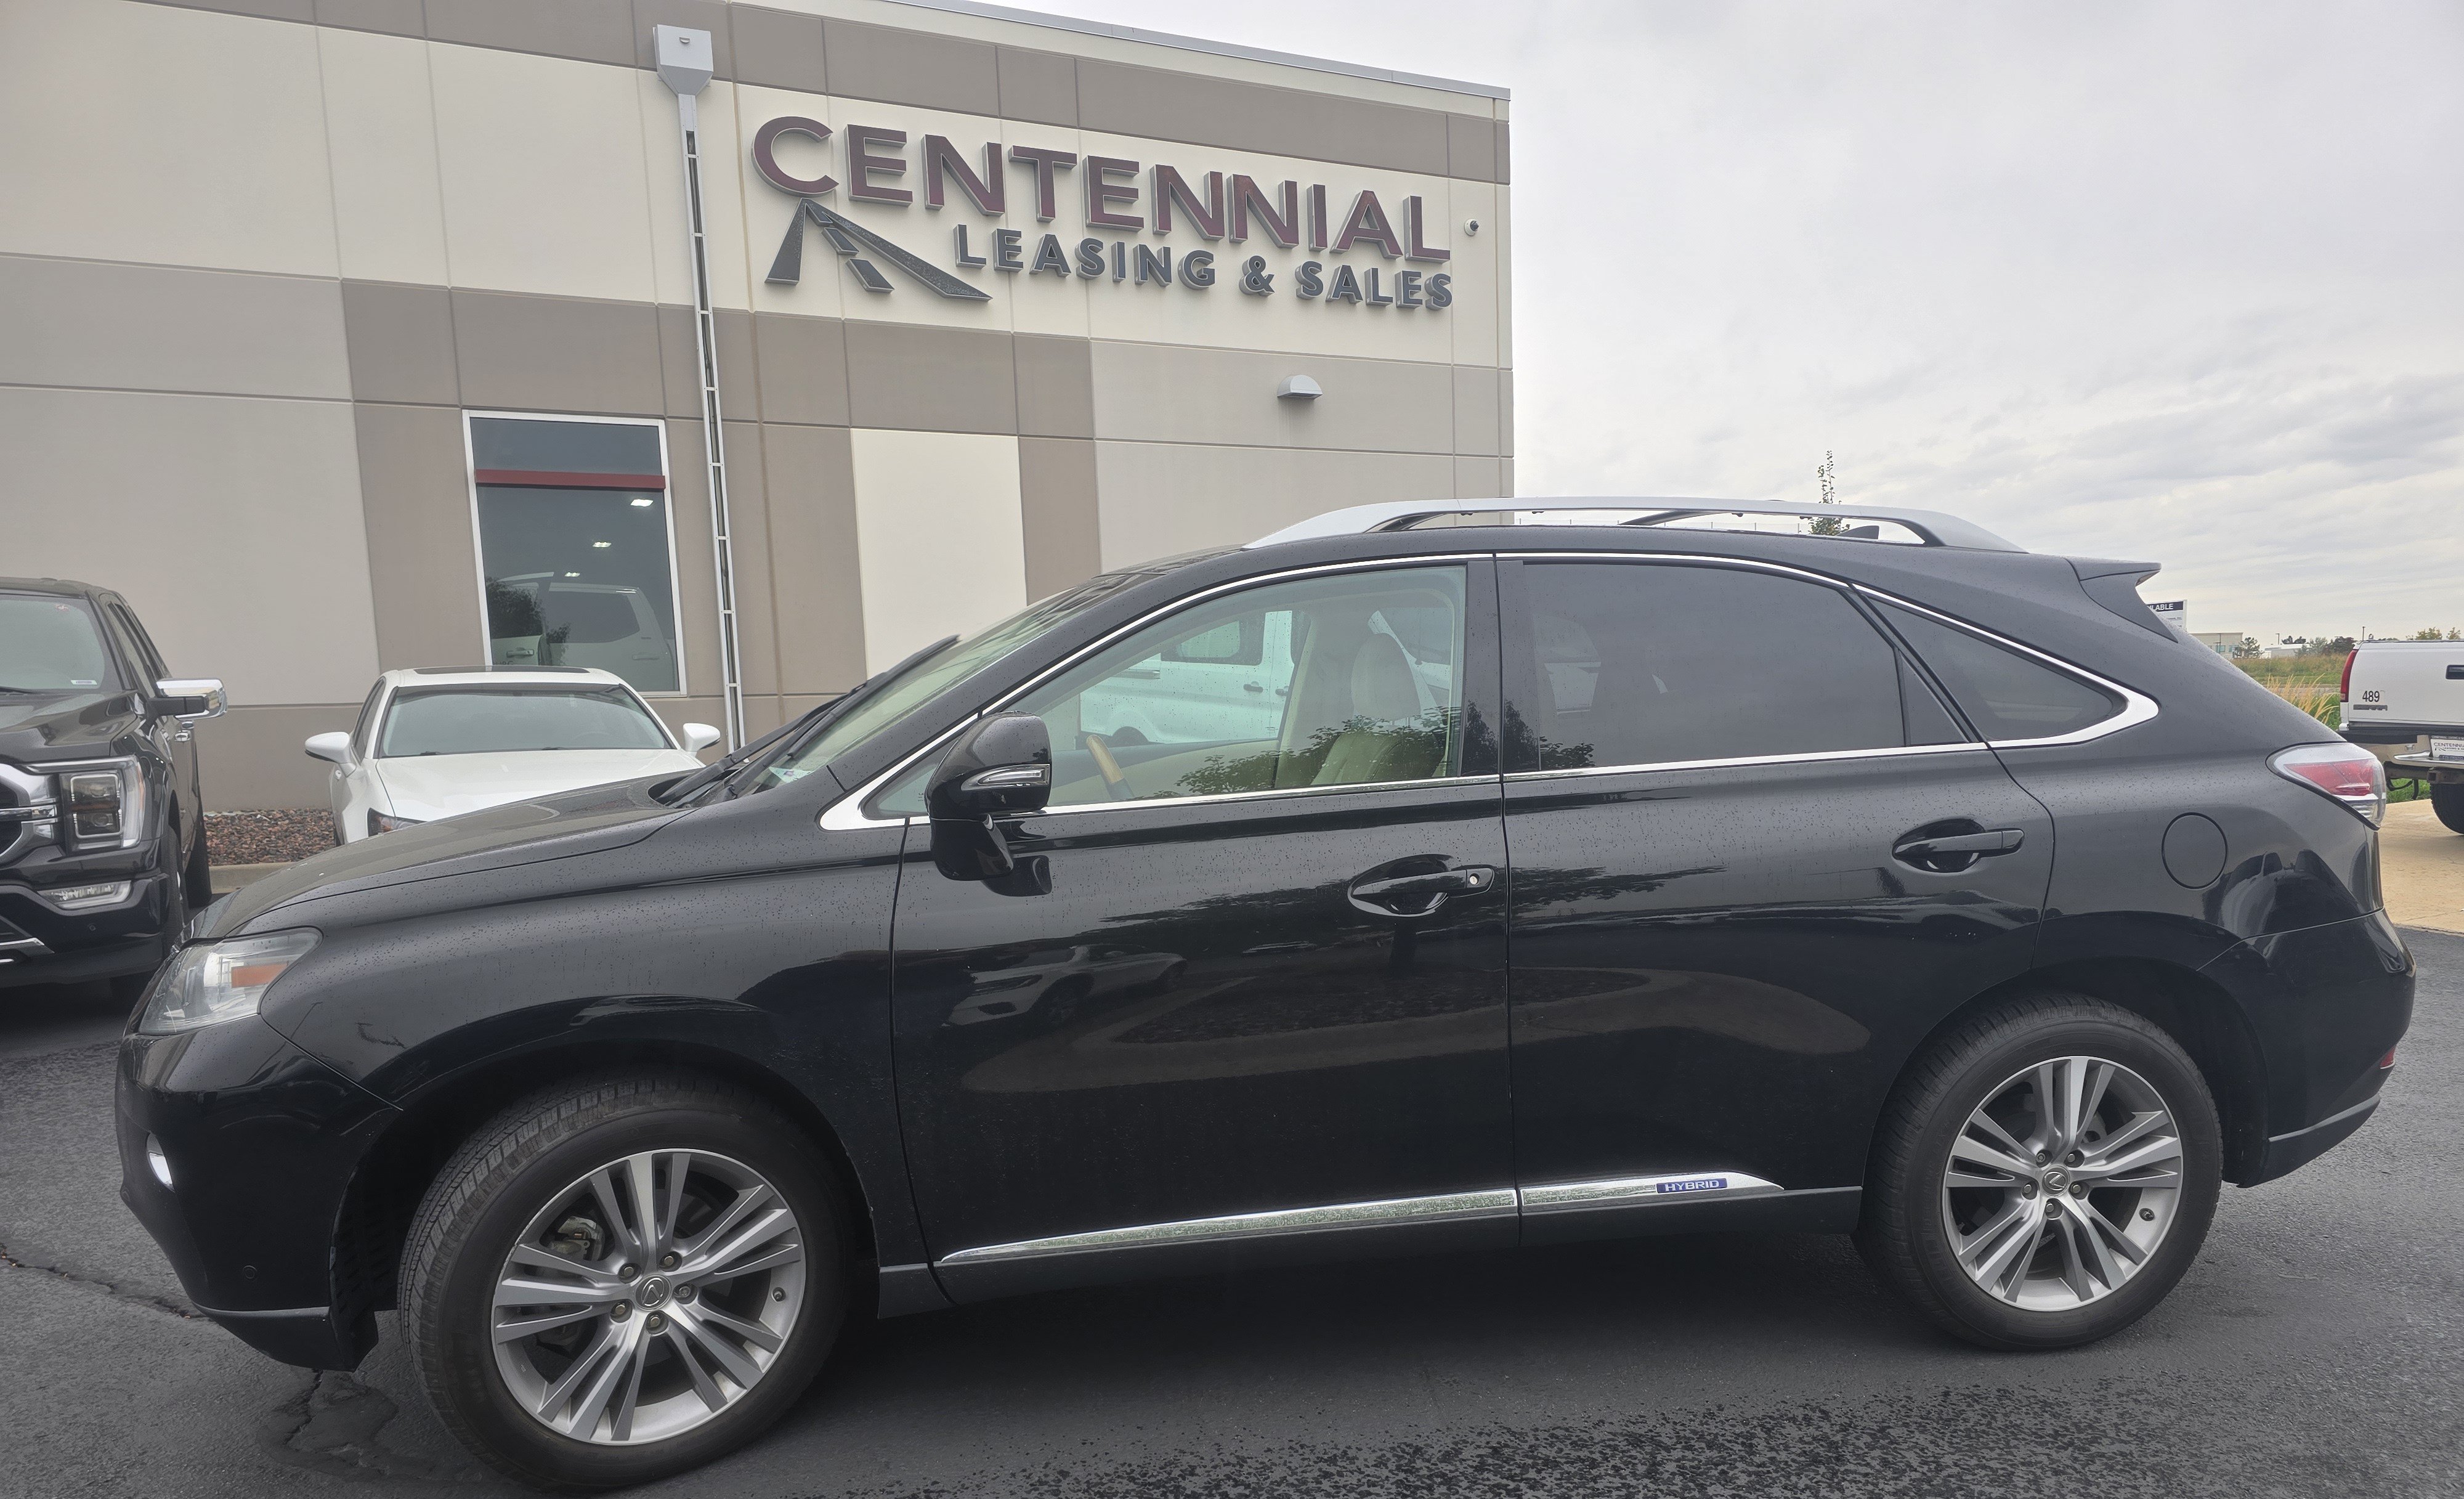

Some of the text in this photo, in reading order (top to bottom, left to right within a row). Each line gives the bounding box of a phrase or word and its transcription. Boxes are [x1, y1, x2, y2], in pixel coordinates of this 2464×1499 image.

[752, 116, 1450, 261] CENTENNIAL
[953, 224, 1453, 310] LEASING & SALES
[2362, 690, 2380, 702] 489
[1664, 1180, 1719, 1192] HYBRID
